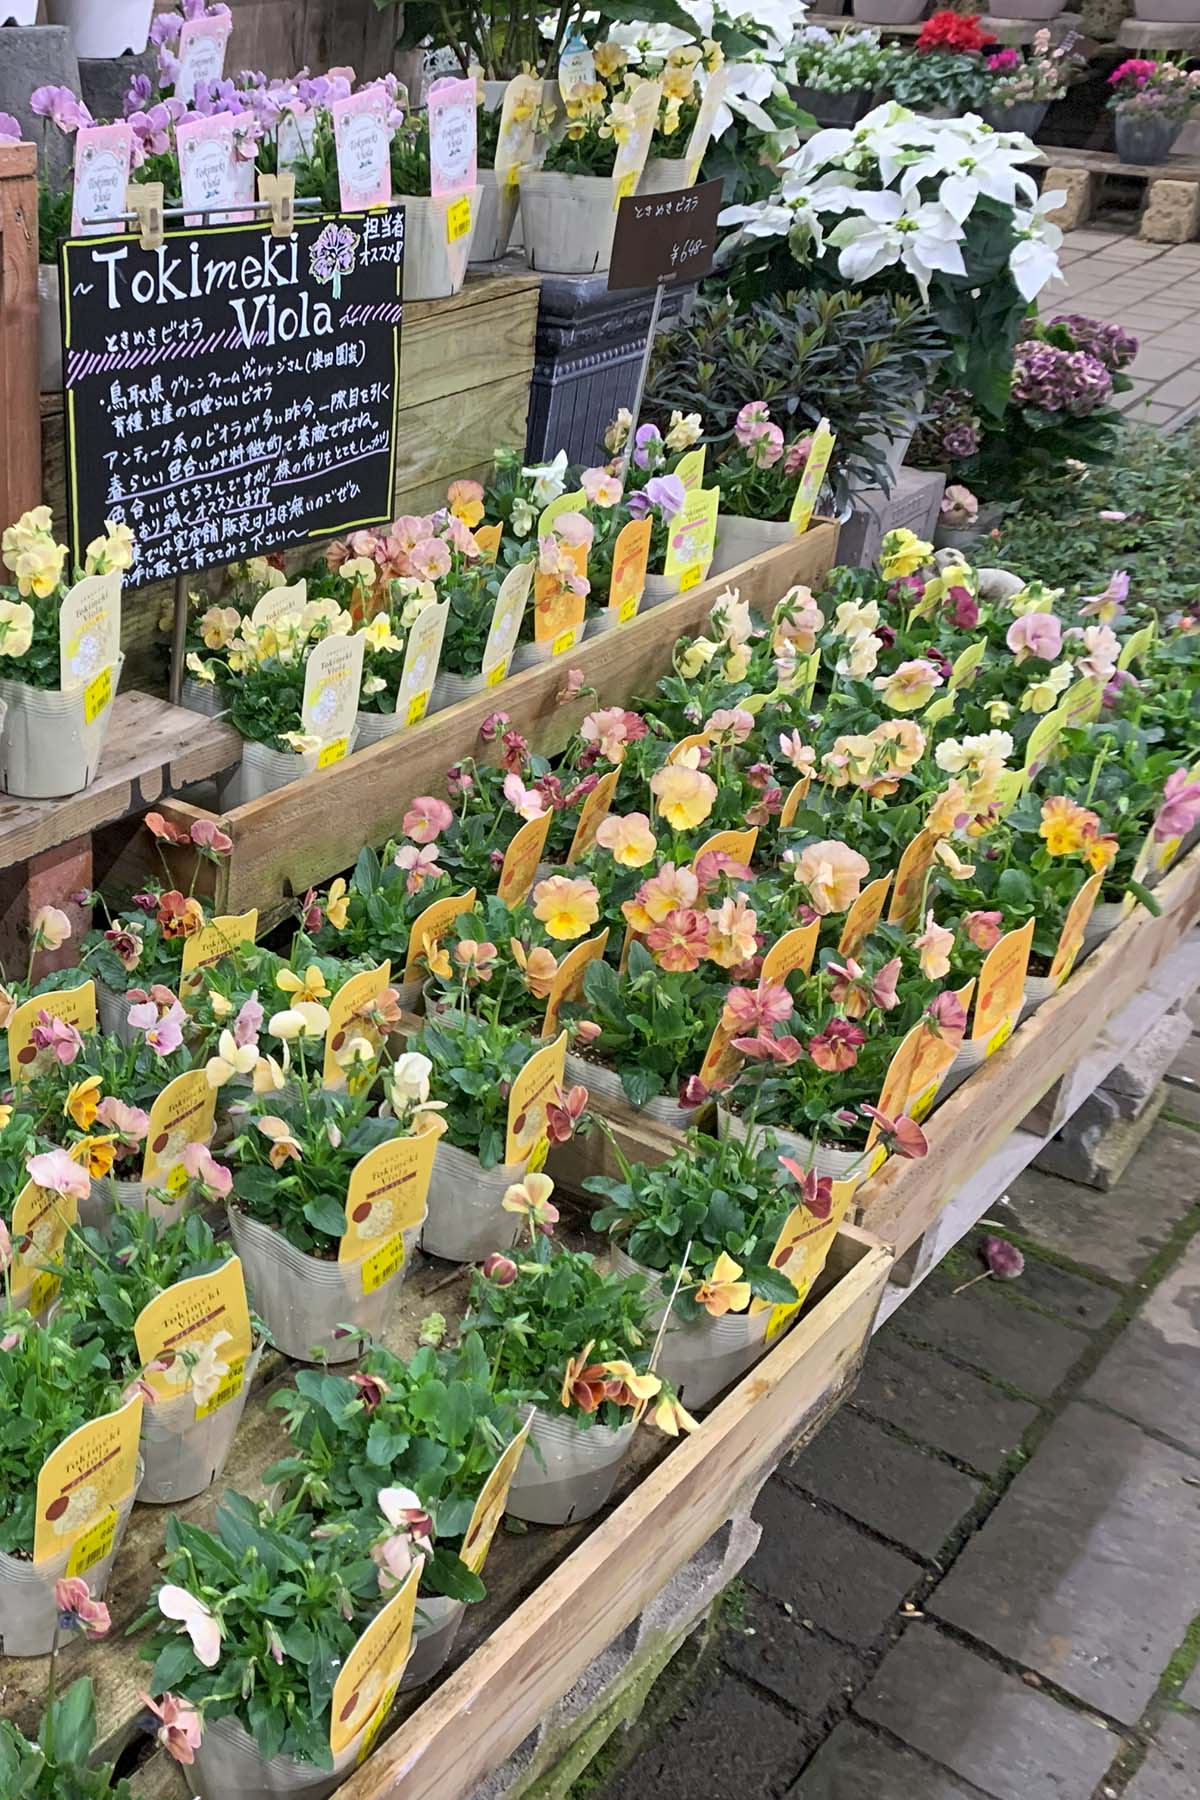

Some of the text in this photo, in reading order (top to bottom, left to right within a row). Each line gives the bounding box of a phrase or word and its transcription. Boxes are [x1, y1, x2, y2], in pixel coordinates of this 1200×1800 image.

[363, 212, 404, 239] 担当者
[105, 317, 204, 351] ときめきビオラ
[229, 291, 334, 350] Viola
